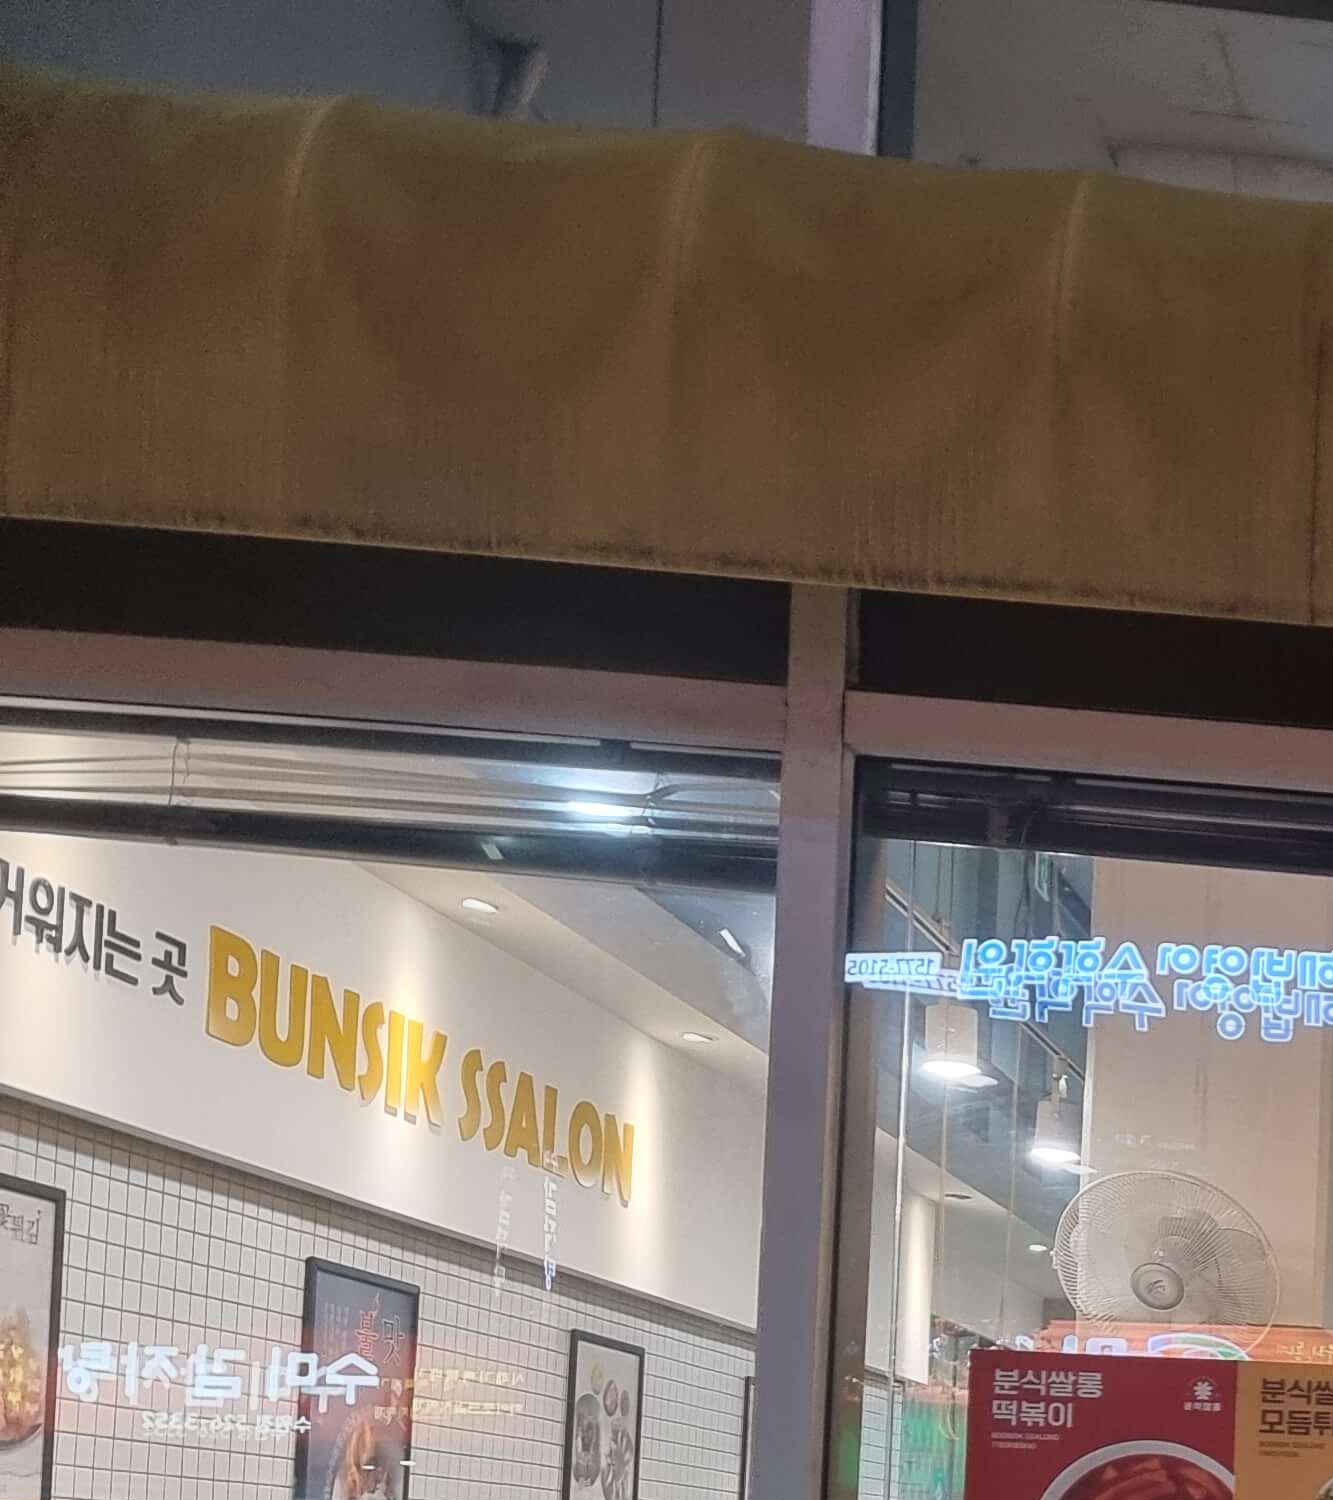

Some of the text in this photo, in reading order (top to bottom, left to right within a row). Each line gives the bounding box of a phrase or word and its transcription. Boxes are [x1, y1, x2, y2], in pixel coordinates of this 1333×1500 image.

[151, 931, 188, 1005] 곳
[206, 925, 636, 1207] BUNSIK SSALON
[993, 1368, 1104, 1399] 분식쌀롱
[991, 1399, 1073, 1428] 떡볶이
